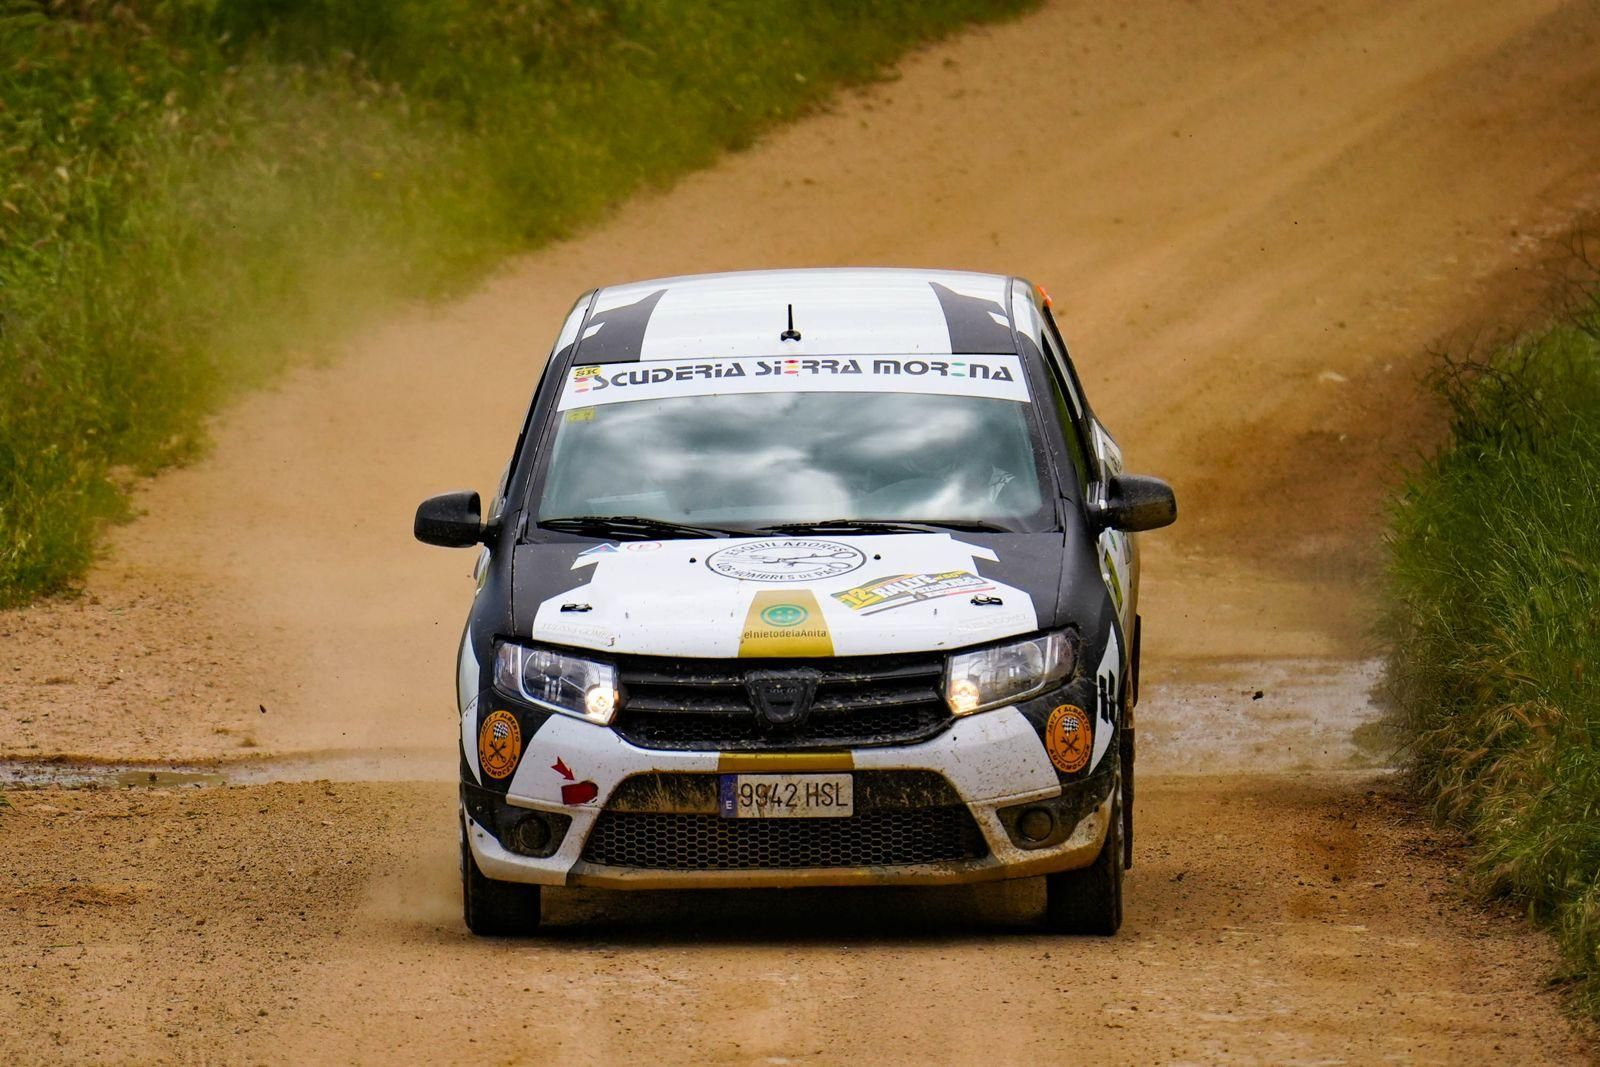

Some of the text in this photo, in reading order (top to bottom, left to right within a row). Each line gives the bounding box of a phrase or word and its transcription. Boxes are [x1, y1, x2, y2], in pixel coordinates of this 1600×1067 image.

[740, 782, 849, 808] 9942 HSL
[725, 800, 732, 810] E
